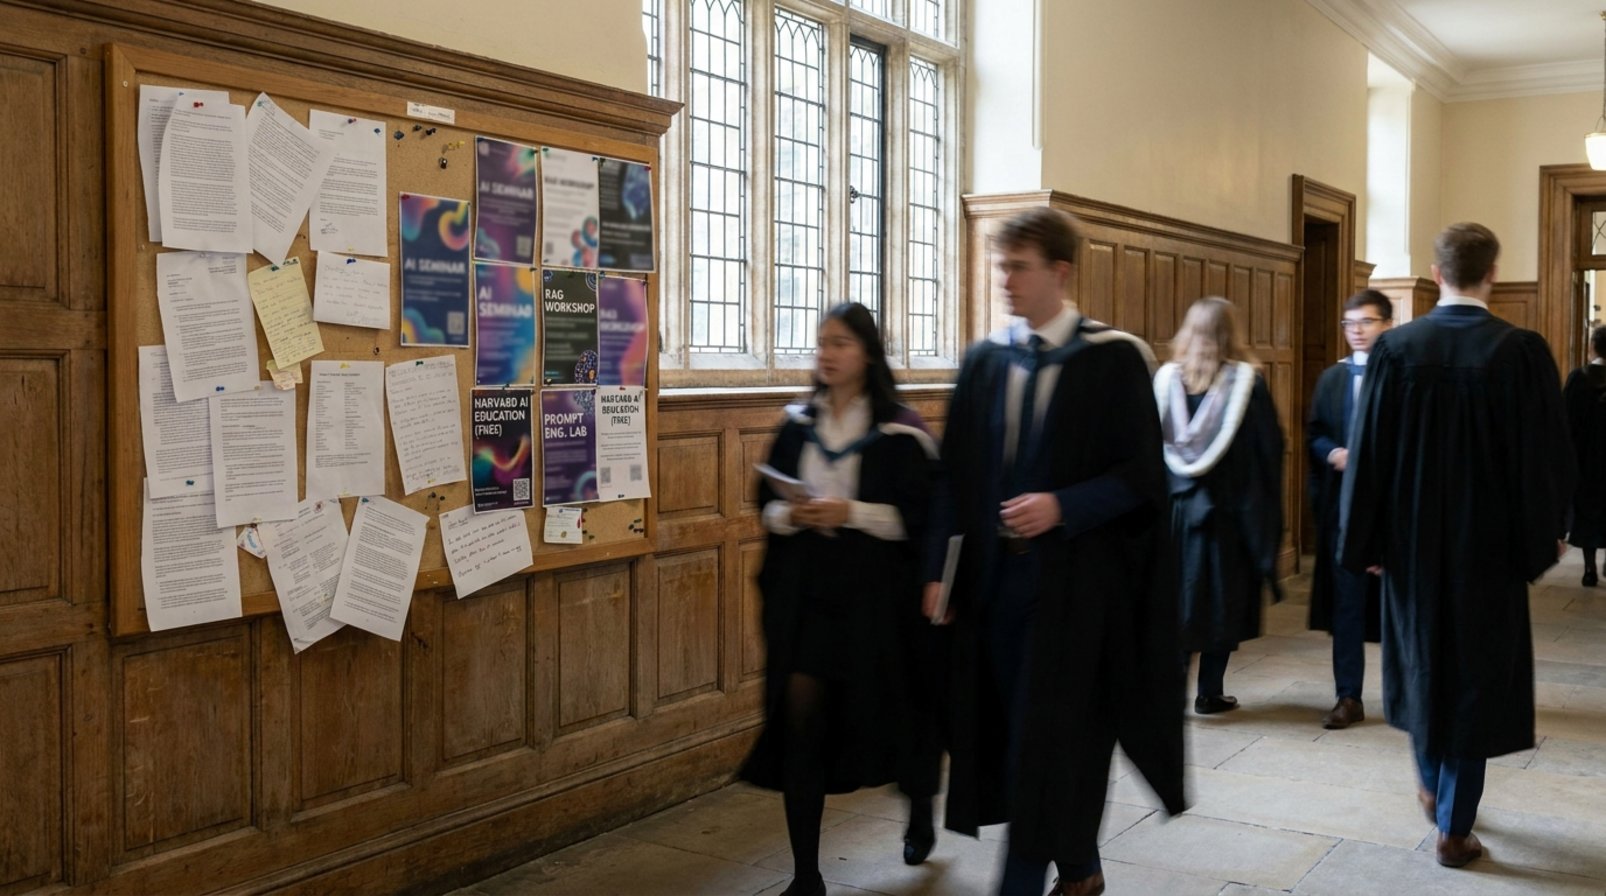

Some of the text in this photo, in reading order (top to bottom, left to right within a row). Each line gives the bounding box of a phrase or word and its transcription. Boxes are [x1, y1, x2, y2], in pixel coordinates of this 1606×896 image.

[545, 288, 564, 300] RAG
[545, 301, 595, 313] WORKSHOP
[520, 396, 529, 407] AI
[544, 412, 583, 425] PROMPT
[544, 426, 587, 439] ENG. LAB
